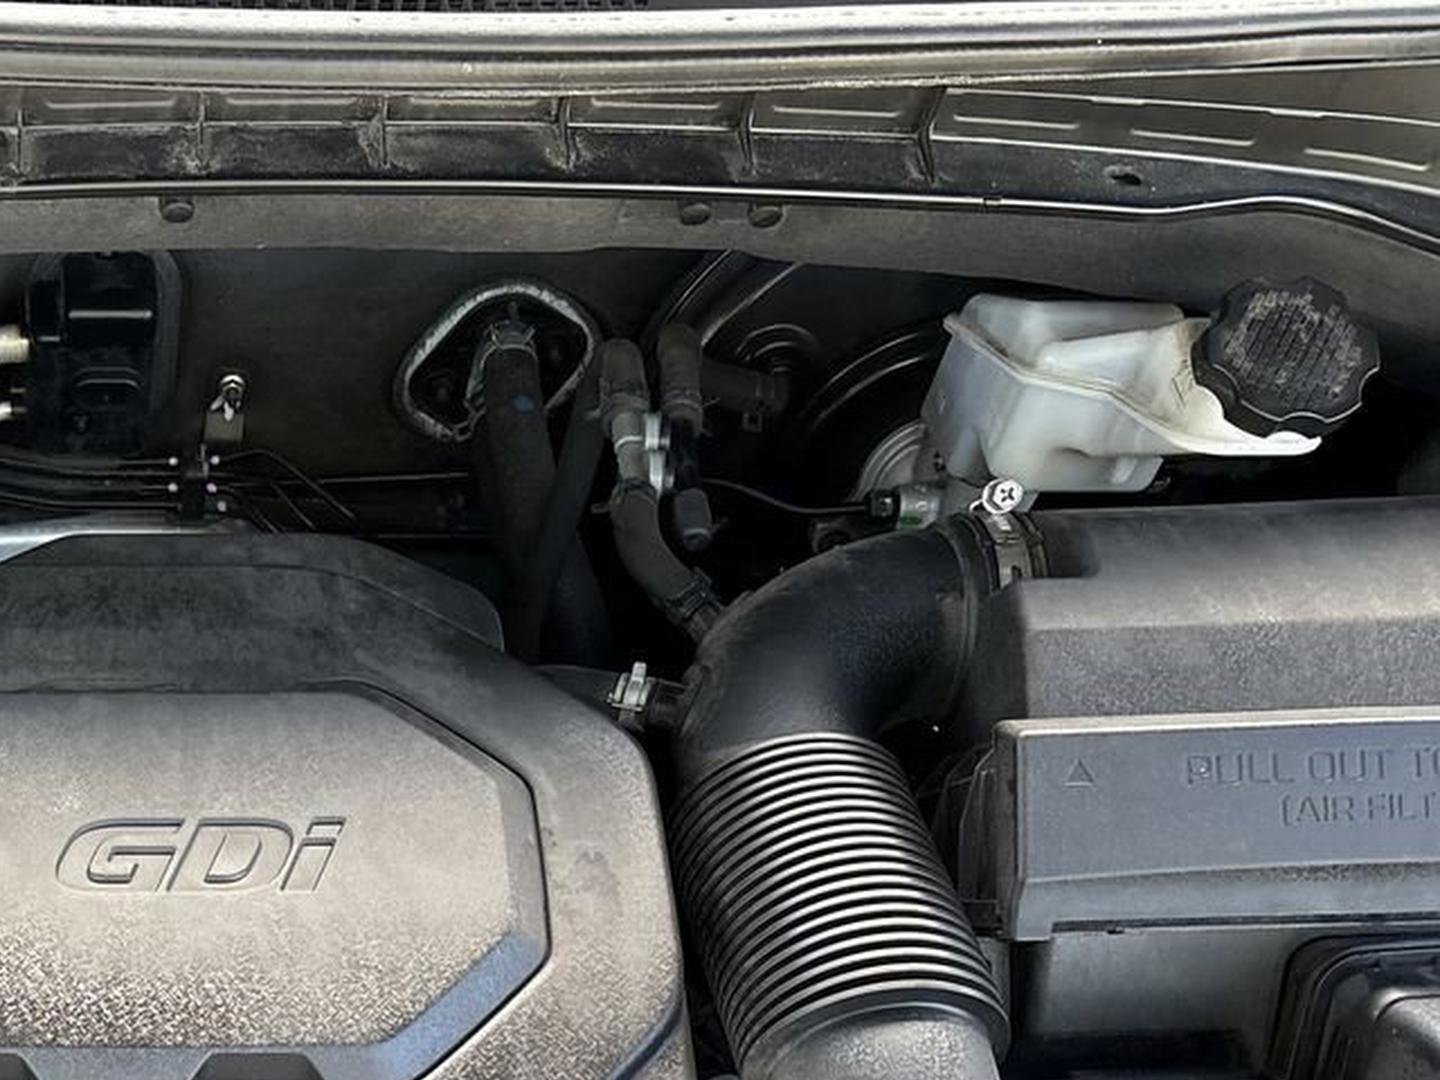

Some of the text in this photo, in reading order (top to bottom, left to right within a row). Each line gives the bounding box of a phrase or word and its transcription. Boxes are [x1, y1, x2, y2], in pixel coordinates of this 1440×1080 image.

[1186, 752, 1294, 786] PULL
[1309, 750, 1391, 782] OUT
[56, 817, 346, 893] GDi
